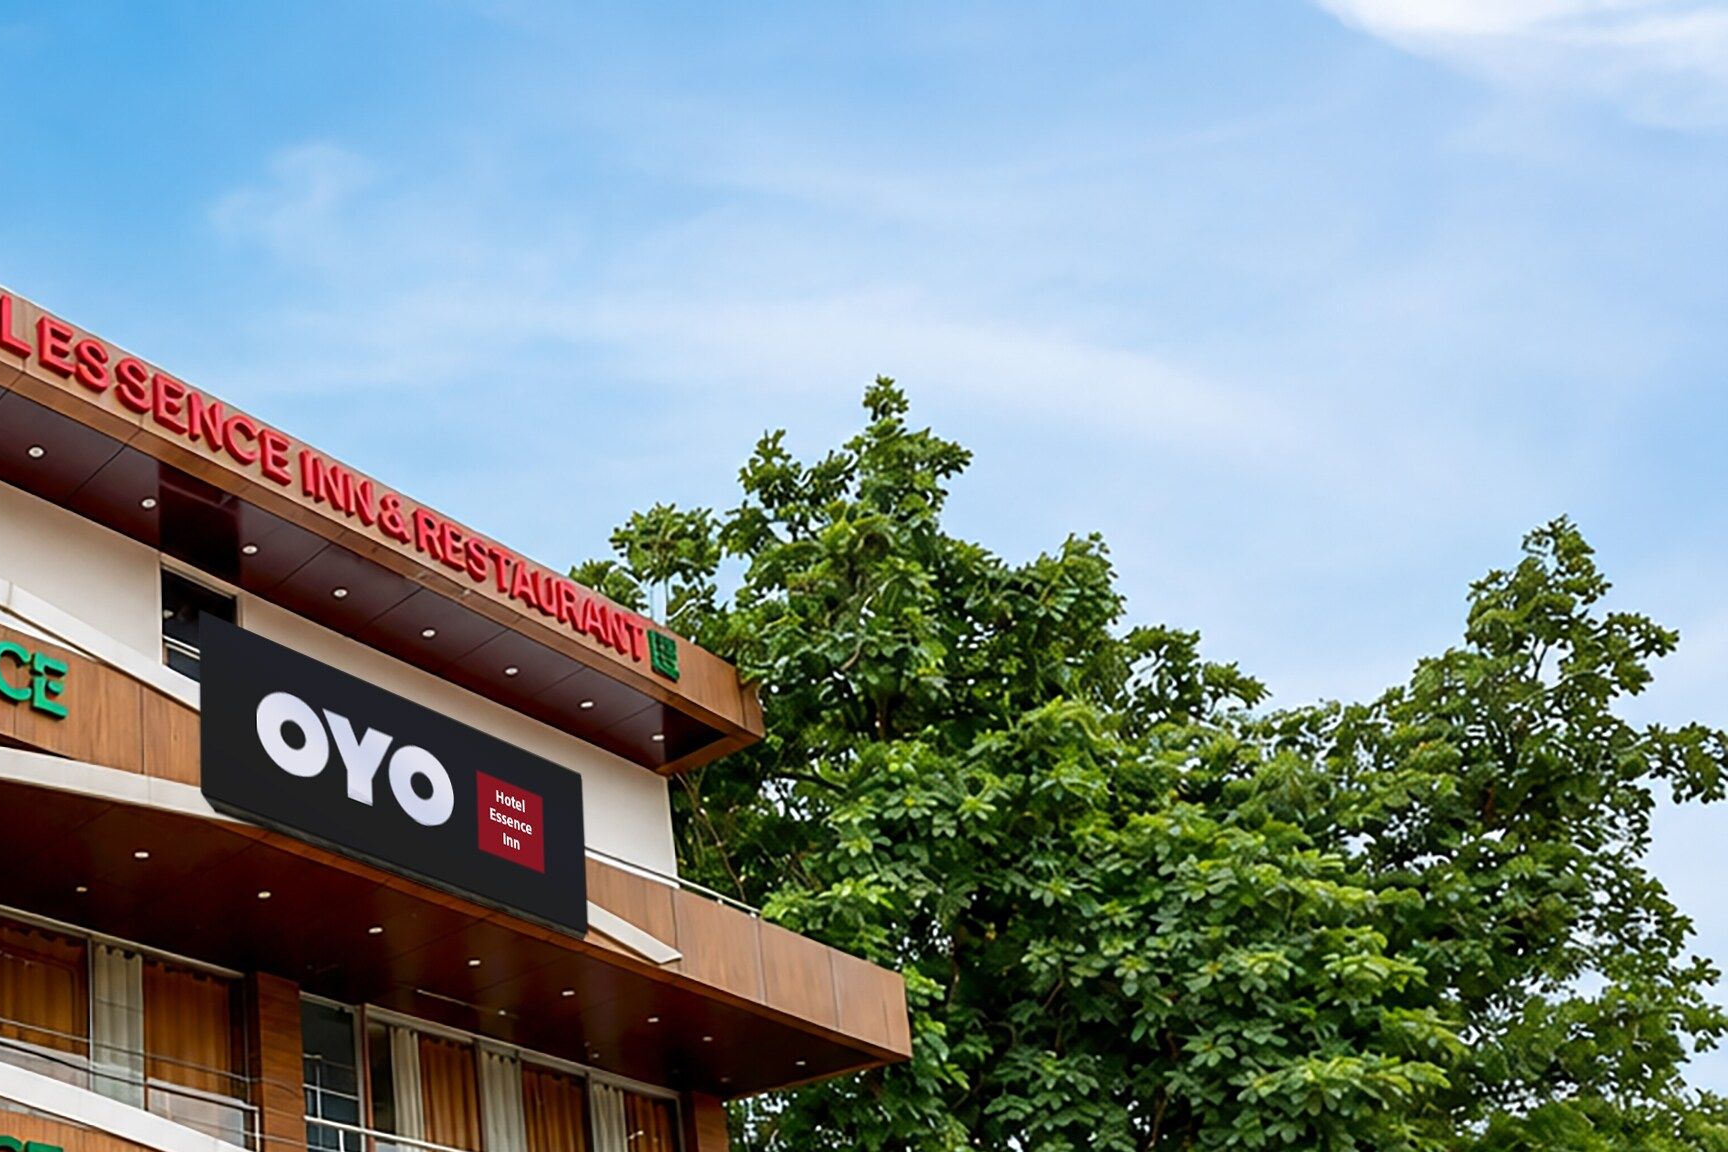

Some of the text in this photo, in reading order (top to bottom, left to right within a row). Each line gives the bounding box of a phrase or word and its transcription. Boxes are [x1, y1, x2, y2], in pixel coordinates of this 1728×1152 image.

[35, 314, 292, 486] ESSENCE
[299, 449, 375, 526] INN
[377, 494, 411, 545] &
[412, 508, 645, 663] RESTAURANT
[256, 691, 454, 827] OYO
[495, 789, 526, 813] Hotel
[489, 806, 533, 835] Essence
[502, 832, 521, 851] Inn
